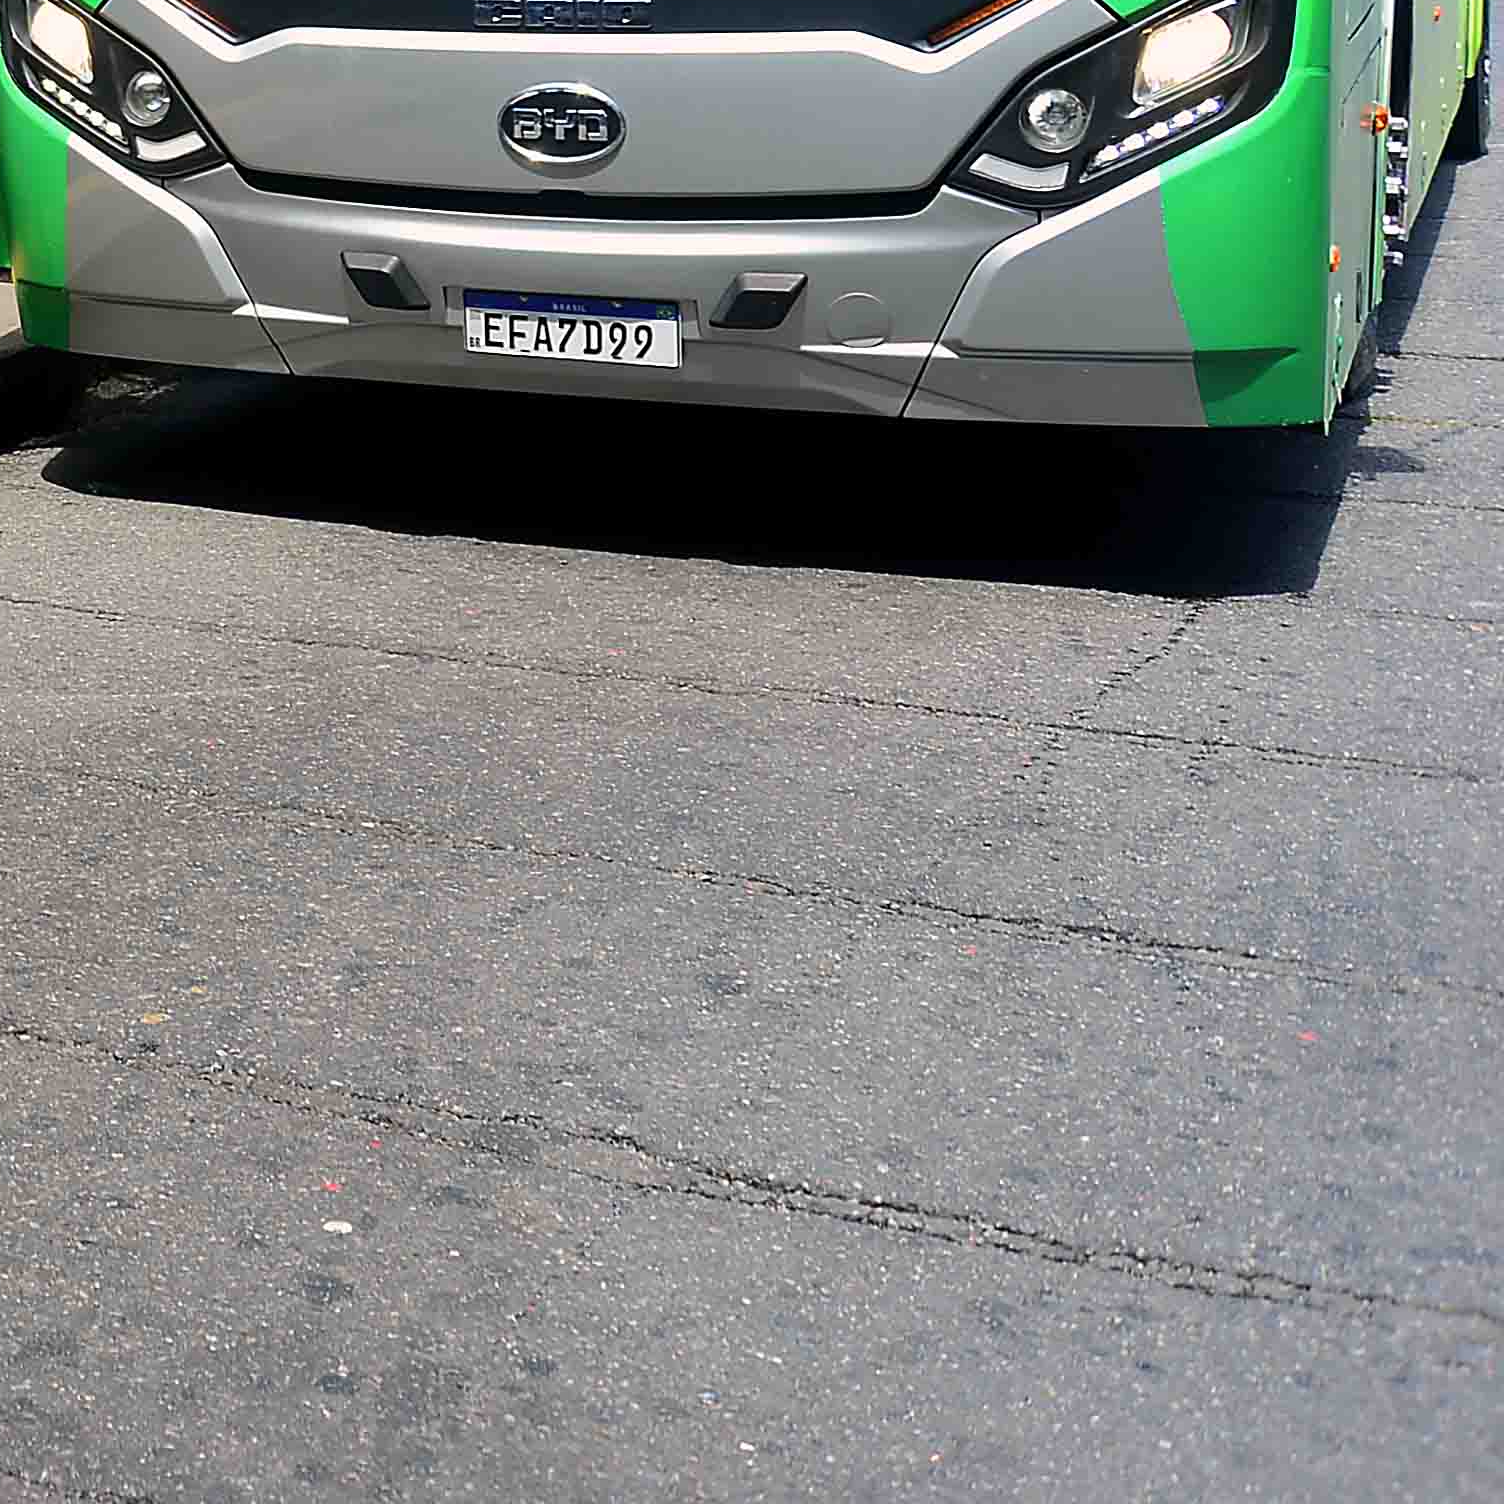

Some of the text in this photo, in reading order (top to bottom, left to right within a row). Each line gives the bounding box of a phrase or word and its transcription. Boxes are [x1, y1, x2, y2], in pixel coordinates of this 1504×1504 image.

[511, 107, 609, 142] BYD
[552, 303, 588, 313] BRASIL
[483, 312, 654, 360] EFA7D99
